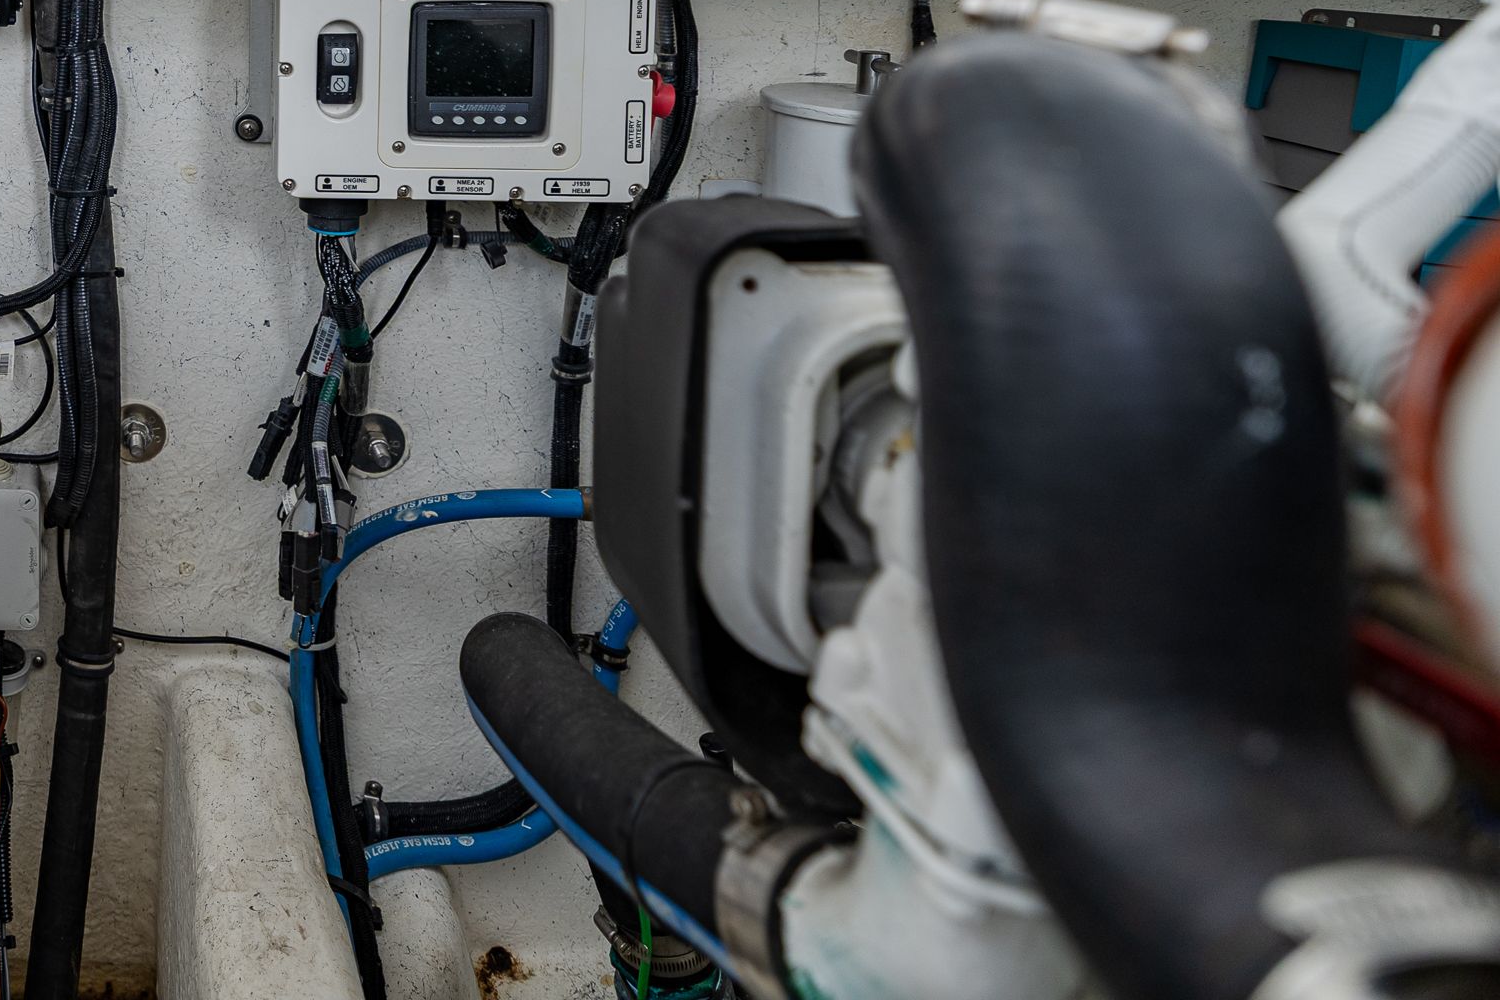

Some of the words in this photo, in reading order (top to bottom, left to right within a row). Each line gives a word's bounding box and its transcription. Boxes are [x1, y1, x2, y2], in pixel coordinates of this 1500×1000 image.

[452, 103, 507, 112] CUMMINS
[402, 838, 422, 849] SAE
[422, 836, 451, 847] 8C5M
[371, 840, 401, 857] J1527
